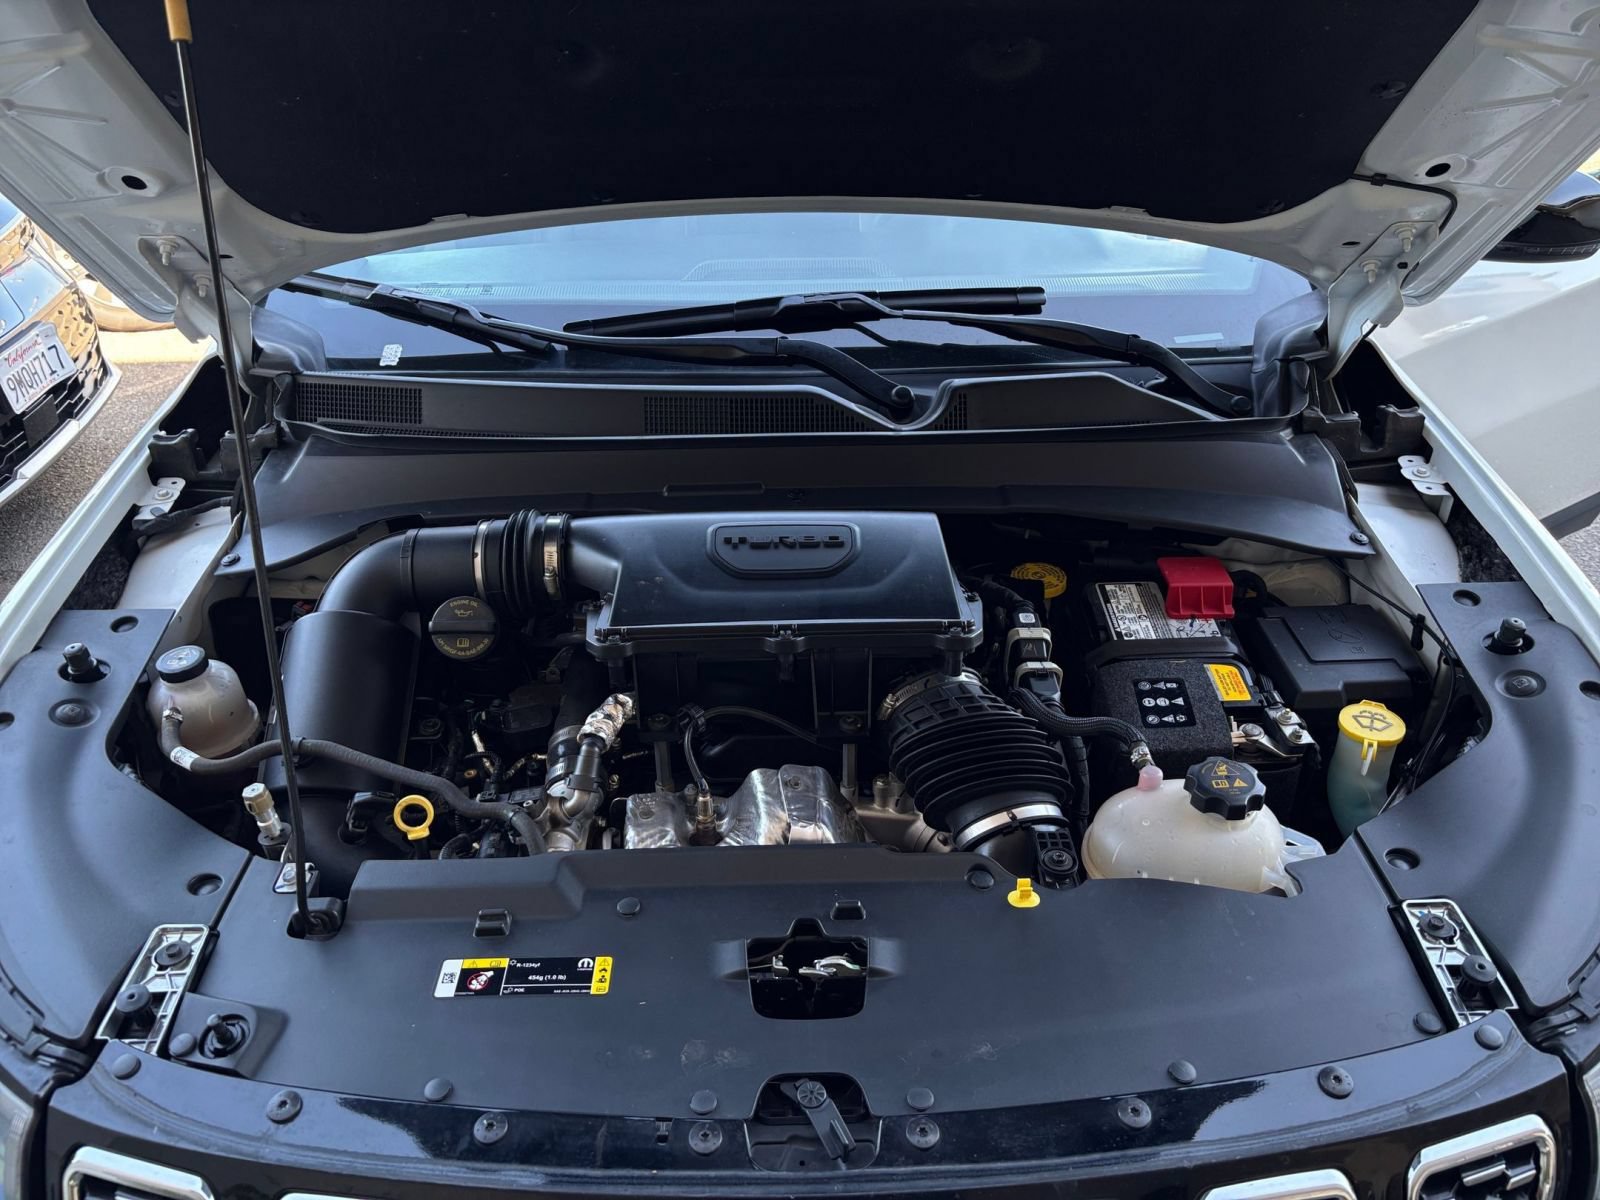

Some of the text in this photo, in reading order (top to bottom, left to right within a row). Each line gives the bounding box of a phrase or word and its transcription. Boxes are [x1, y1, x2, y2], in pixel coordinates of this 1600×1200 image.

[7, 339, 42, 367] California
[6, 344, 65, 404] 9MQH717
[723, 535, 845, 550] TURBO
[449, 599, 478, 608] ENGINE OIL
